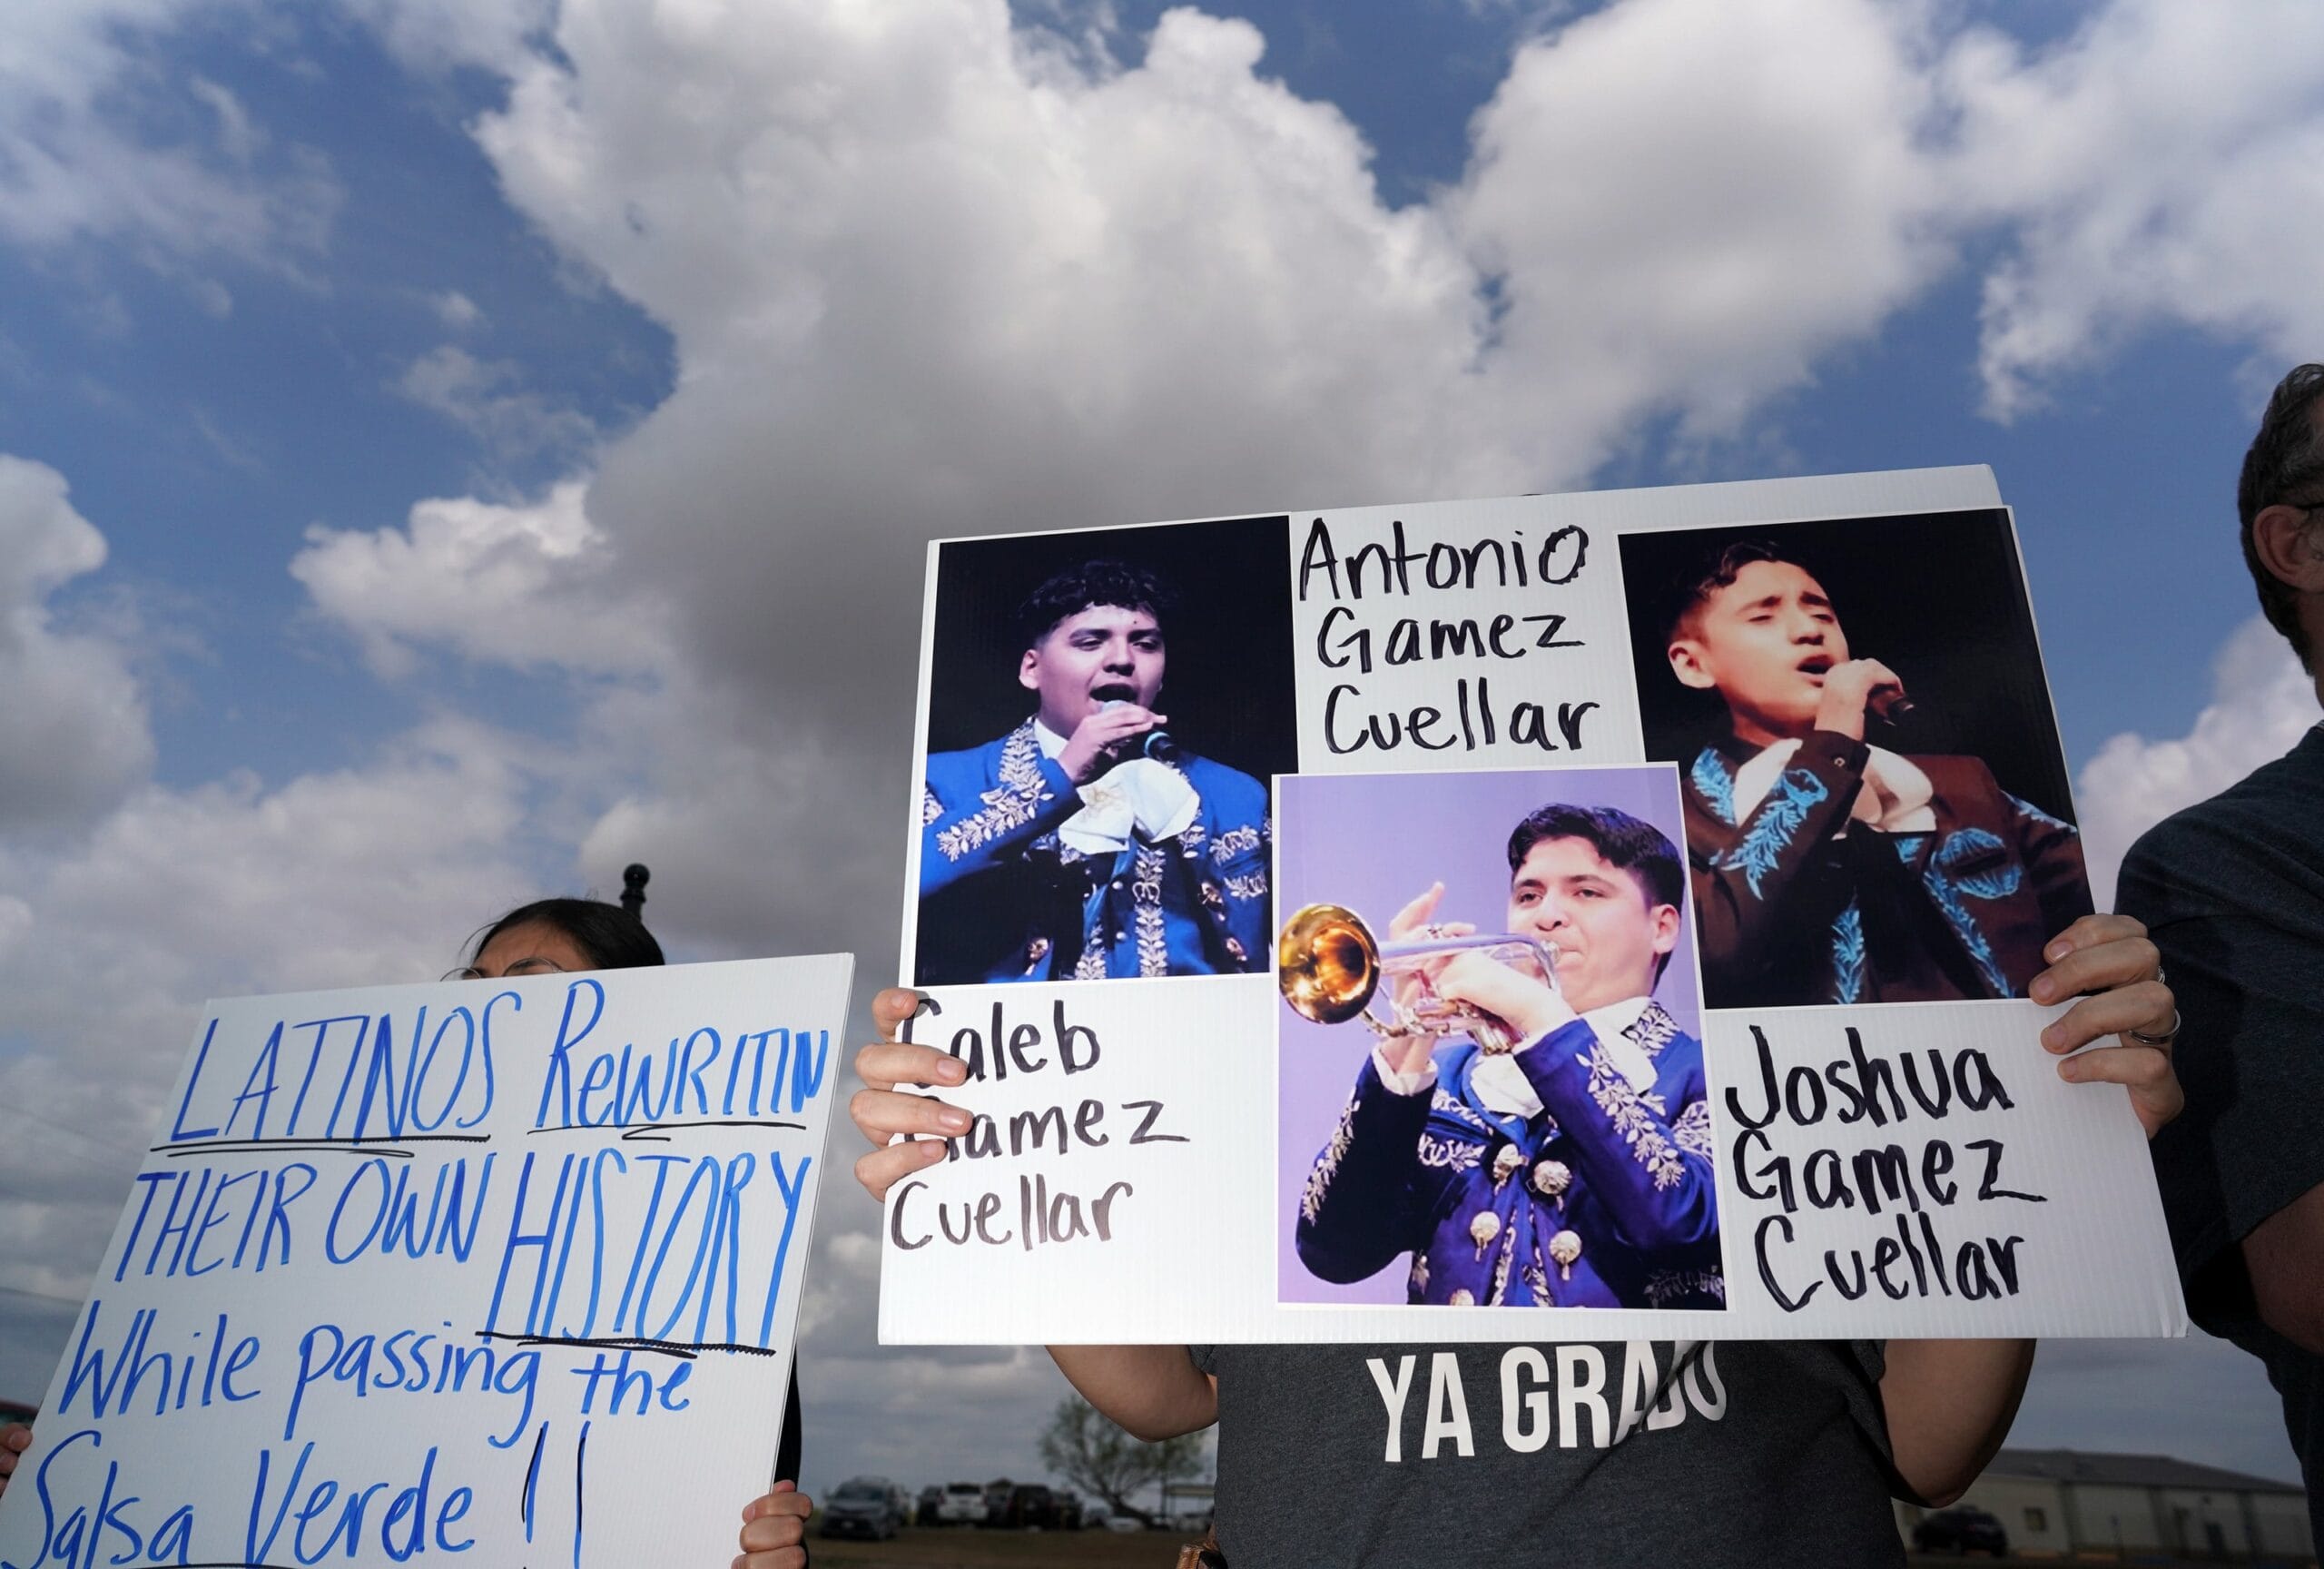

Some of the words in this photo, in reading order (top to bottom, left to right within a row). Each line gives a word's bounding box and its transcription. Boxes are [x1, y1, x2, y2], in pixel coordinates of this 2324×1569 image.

[1300, 518, 1590, 601] Antonio
[1317, 607, 1585, 674] Gamez
[1324, 676, 1600, 755] Cuellar
[170, 991, 522, 1146] LATINOS
[1725, 1025, 2014, 1129] Joshua
[904, 1096, 1191, 1163] amez
[1732, 1129, 2048, 1214] Gamez
[114, 1163, 319, 1283] THEIR
[325, 1151, 498, 1265] OWN
[482, 1148, 812, 1355] HISTORY
[891, 1173, 1134, 1251] Cuellar
[1753, 1210, 2026, 1313] Cuellar
[58, 1299, 262, 1421] While
[282, 1320, 544, 1450] passing
[569, 1351, 694, 1417] the
[1365, 1352, 1475, 1463] YA
[0, 1429, 194, 1569] Salsa
[245, 1441, 476, 1566] Verde
